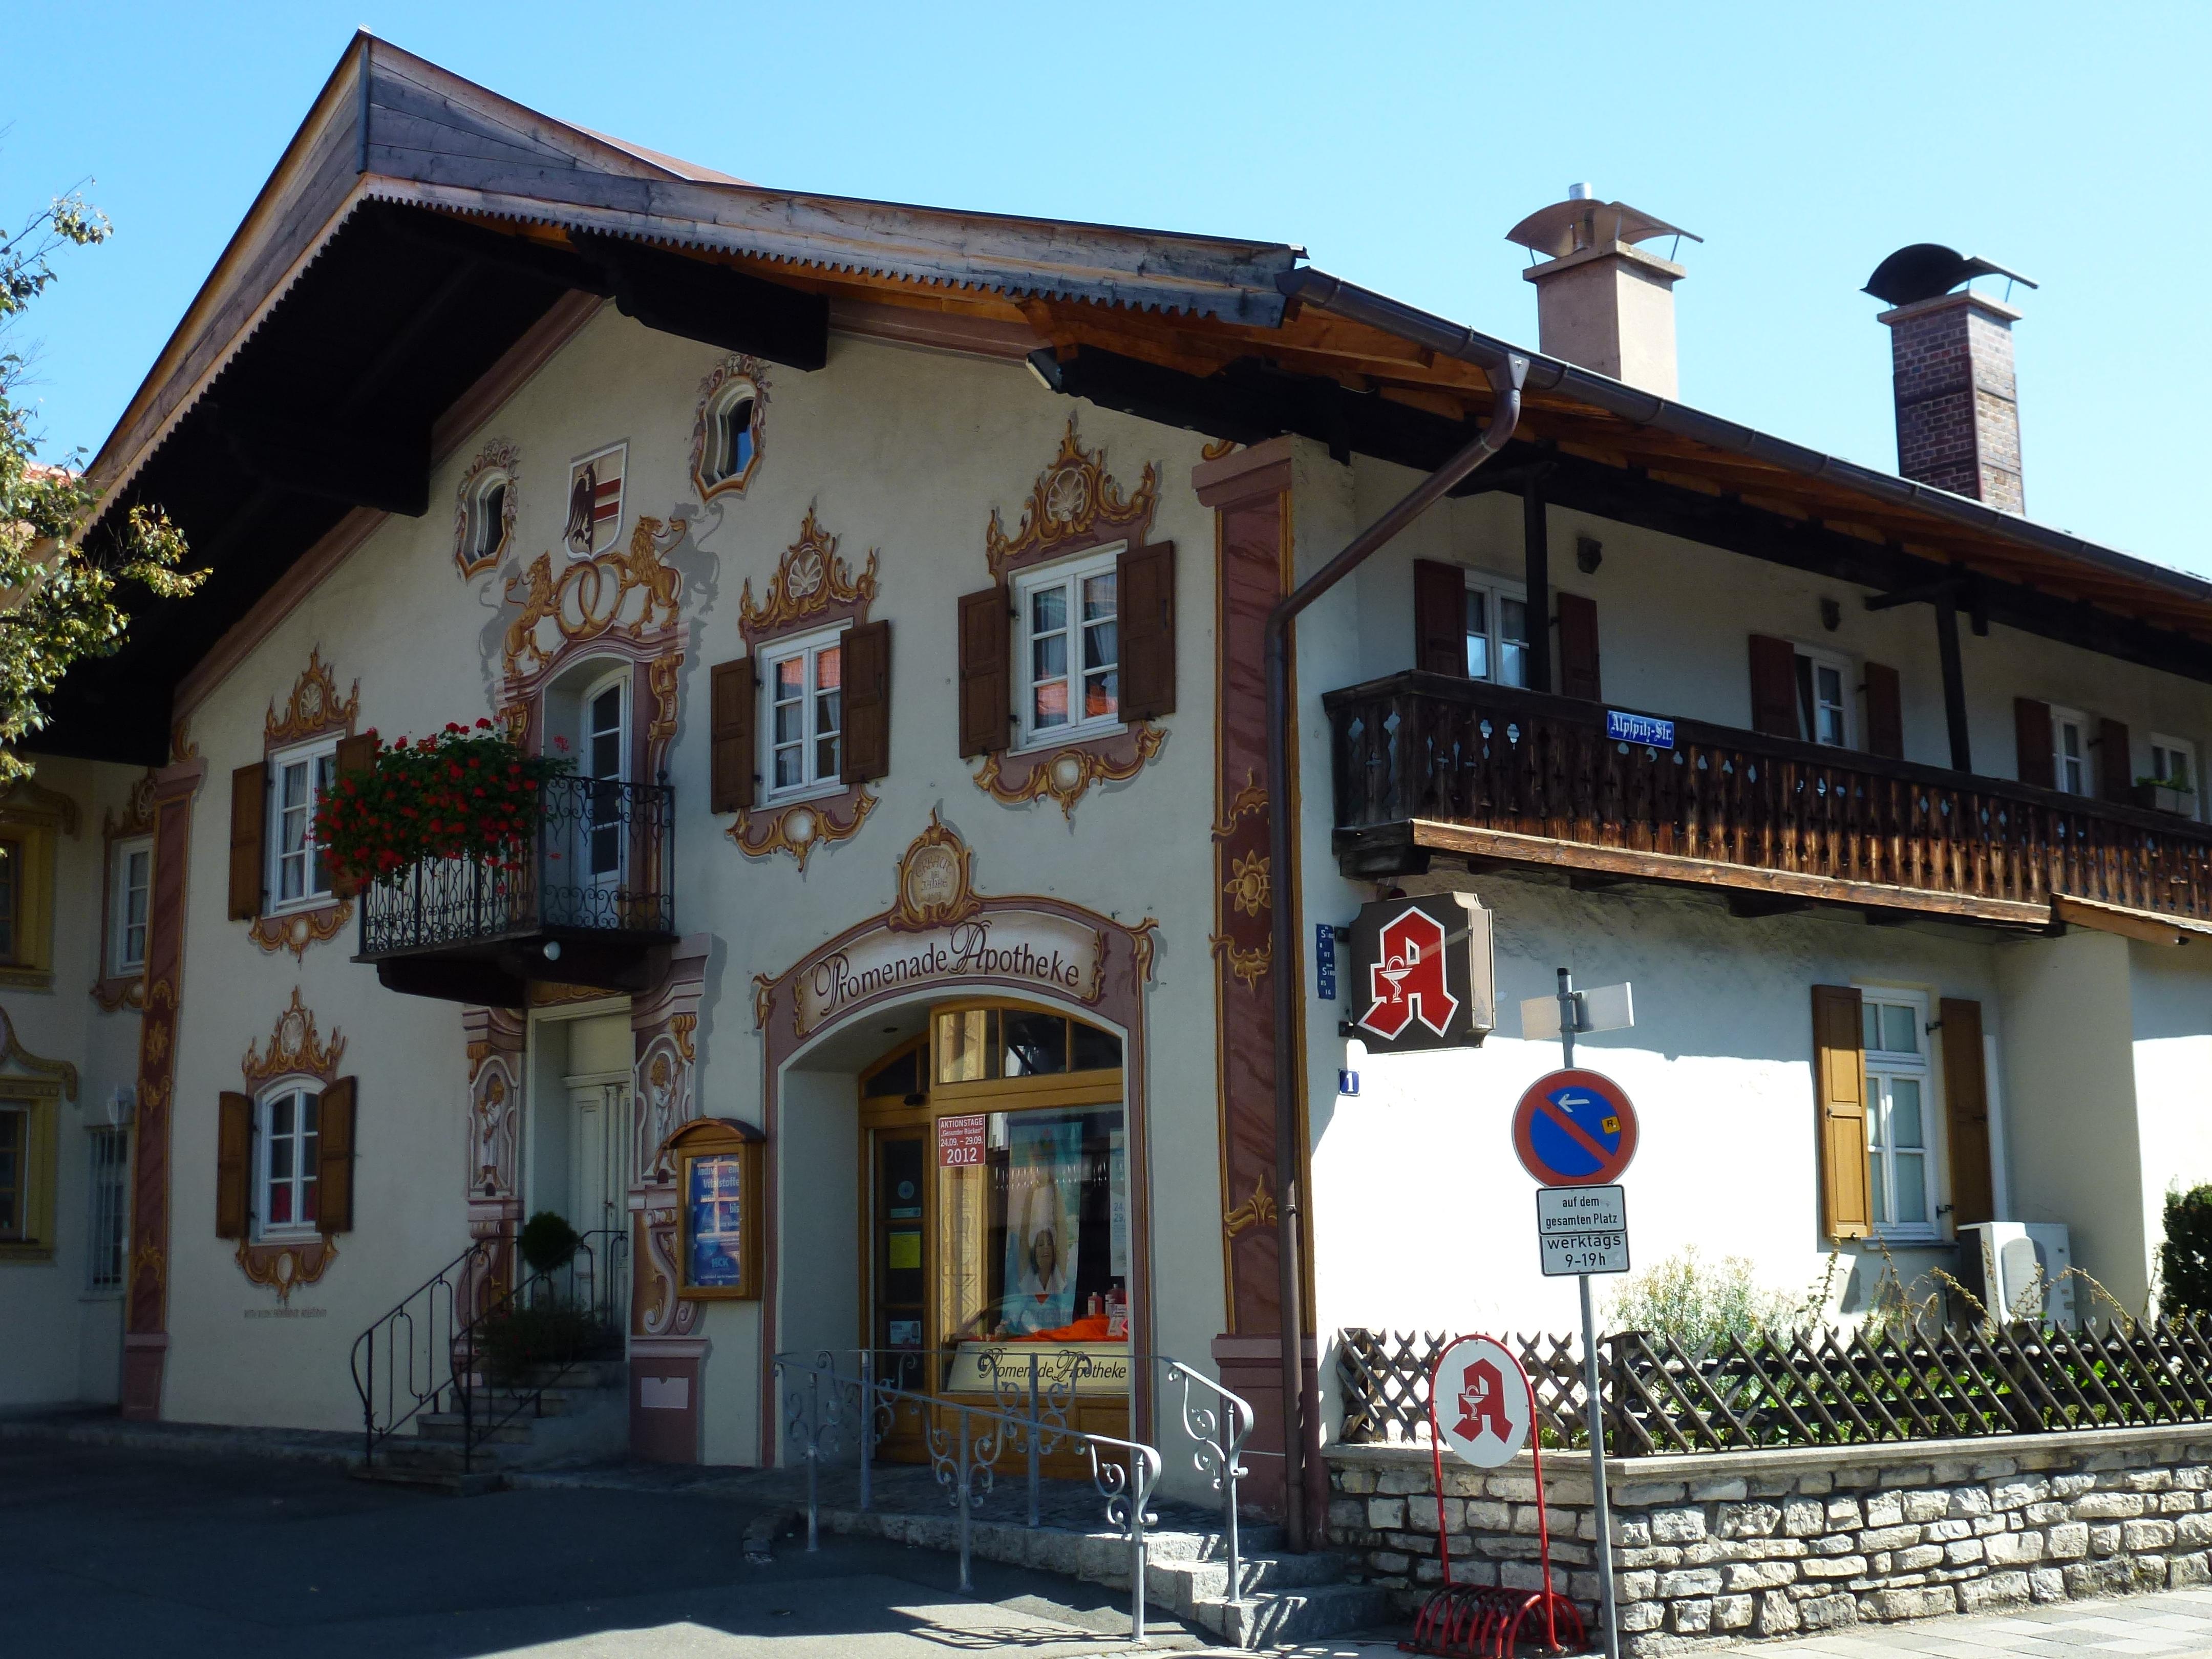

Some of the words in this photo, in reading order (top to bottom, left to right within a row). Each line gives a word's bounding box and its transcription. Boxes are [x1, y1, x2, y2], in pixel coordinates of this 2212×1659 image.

[811, 942, 948, 1016] Promenade
[948, 920, 1079, 987] Apotheke
[1346, 1072, 1354, 1092] 1
[941, 1118, 983, 1129] AKTIONSTAGE
[941, 1138, 959, 1147] 24.09.
[965, 1136, 984, 1145] 29.09.
[947, 1147, 977, 1164] 2012
[1563, 1196, 1577, 1207] auf
[1580, 1196, 1599, 1206] dem
[1546, 1215, 1591, 1229] gesamten
[1593, 1213, 1618, 1224] Platz
[1547, 1235, 1621, 1250] werktags
[979, 1348, 1053, 1378] Pomende
